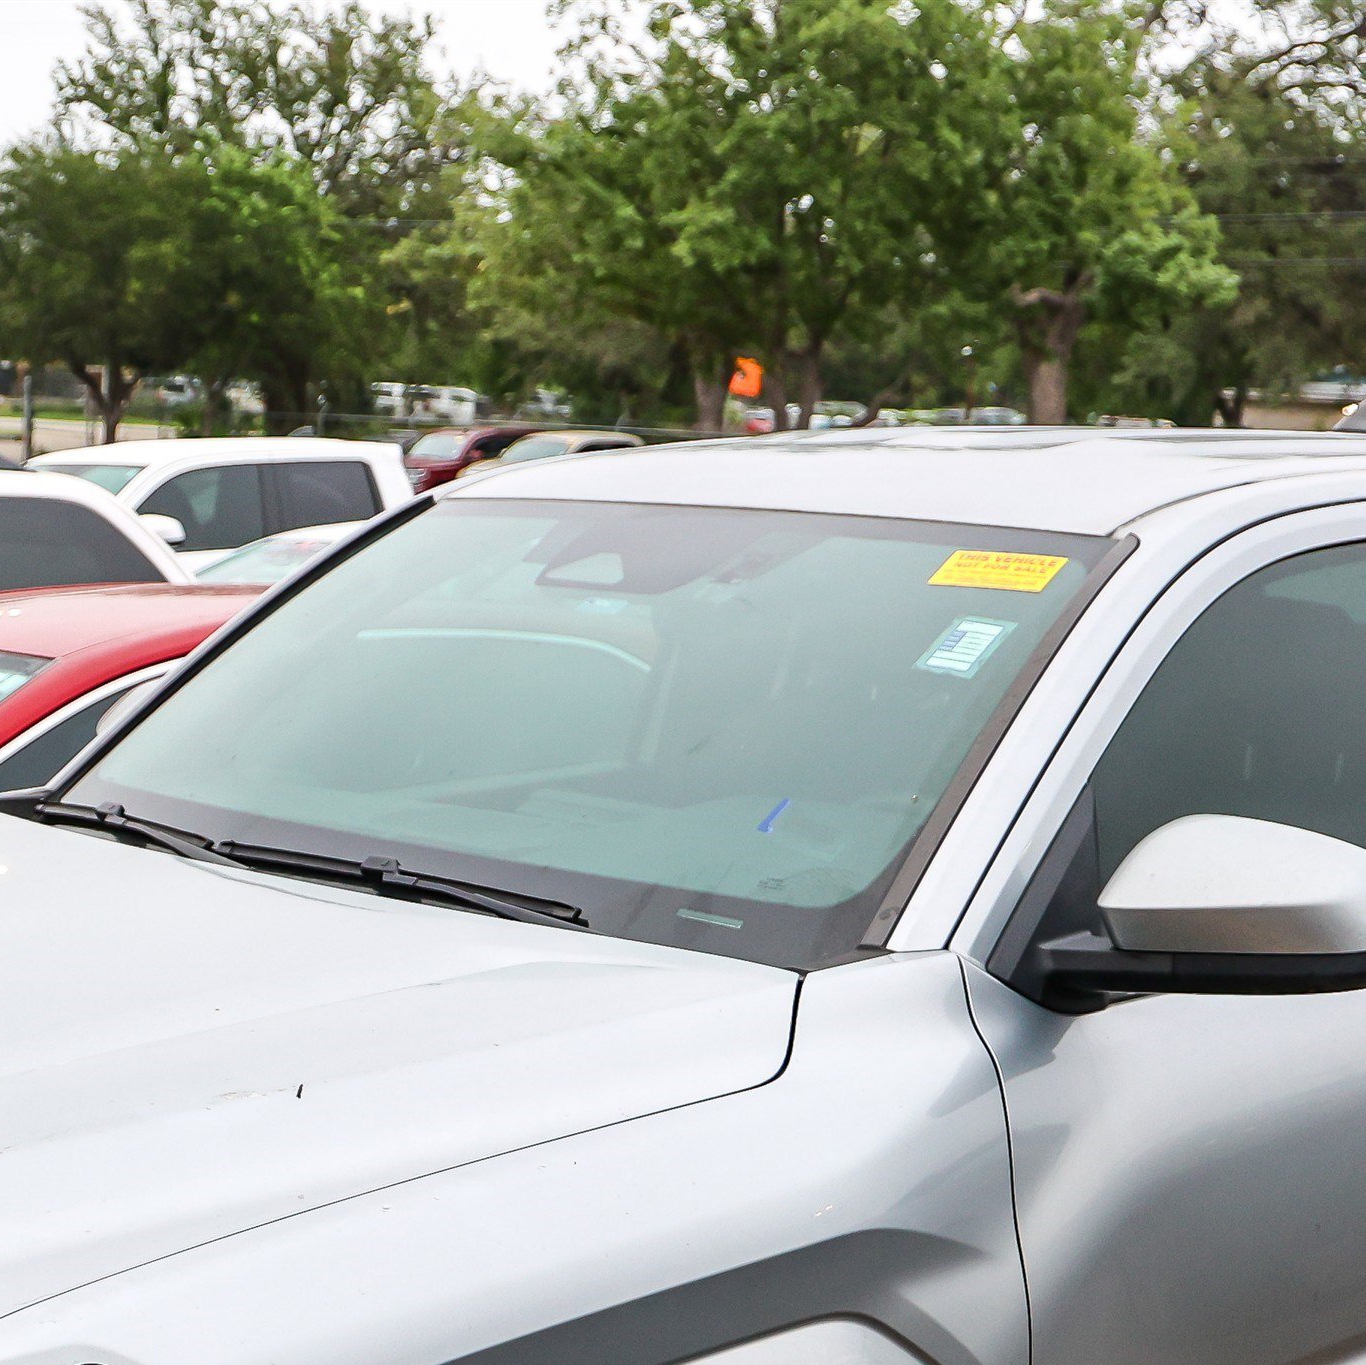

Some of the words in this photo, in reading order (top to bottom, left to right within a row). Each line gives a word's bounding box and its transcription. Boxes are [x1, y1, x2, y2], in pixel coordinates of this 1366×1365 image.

[958, 553, 990, 562] THIS
[995, 555, 1058, 568] VEHICLE
[982, 563, 1011, 571] FOR
[1013, 565, 1048, 575] SALE
